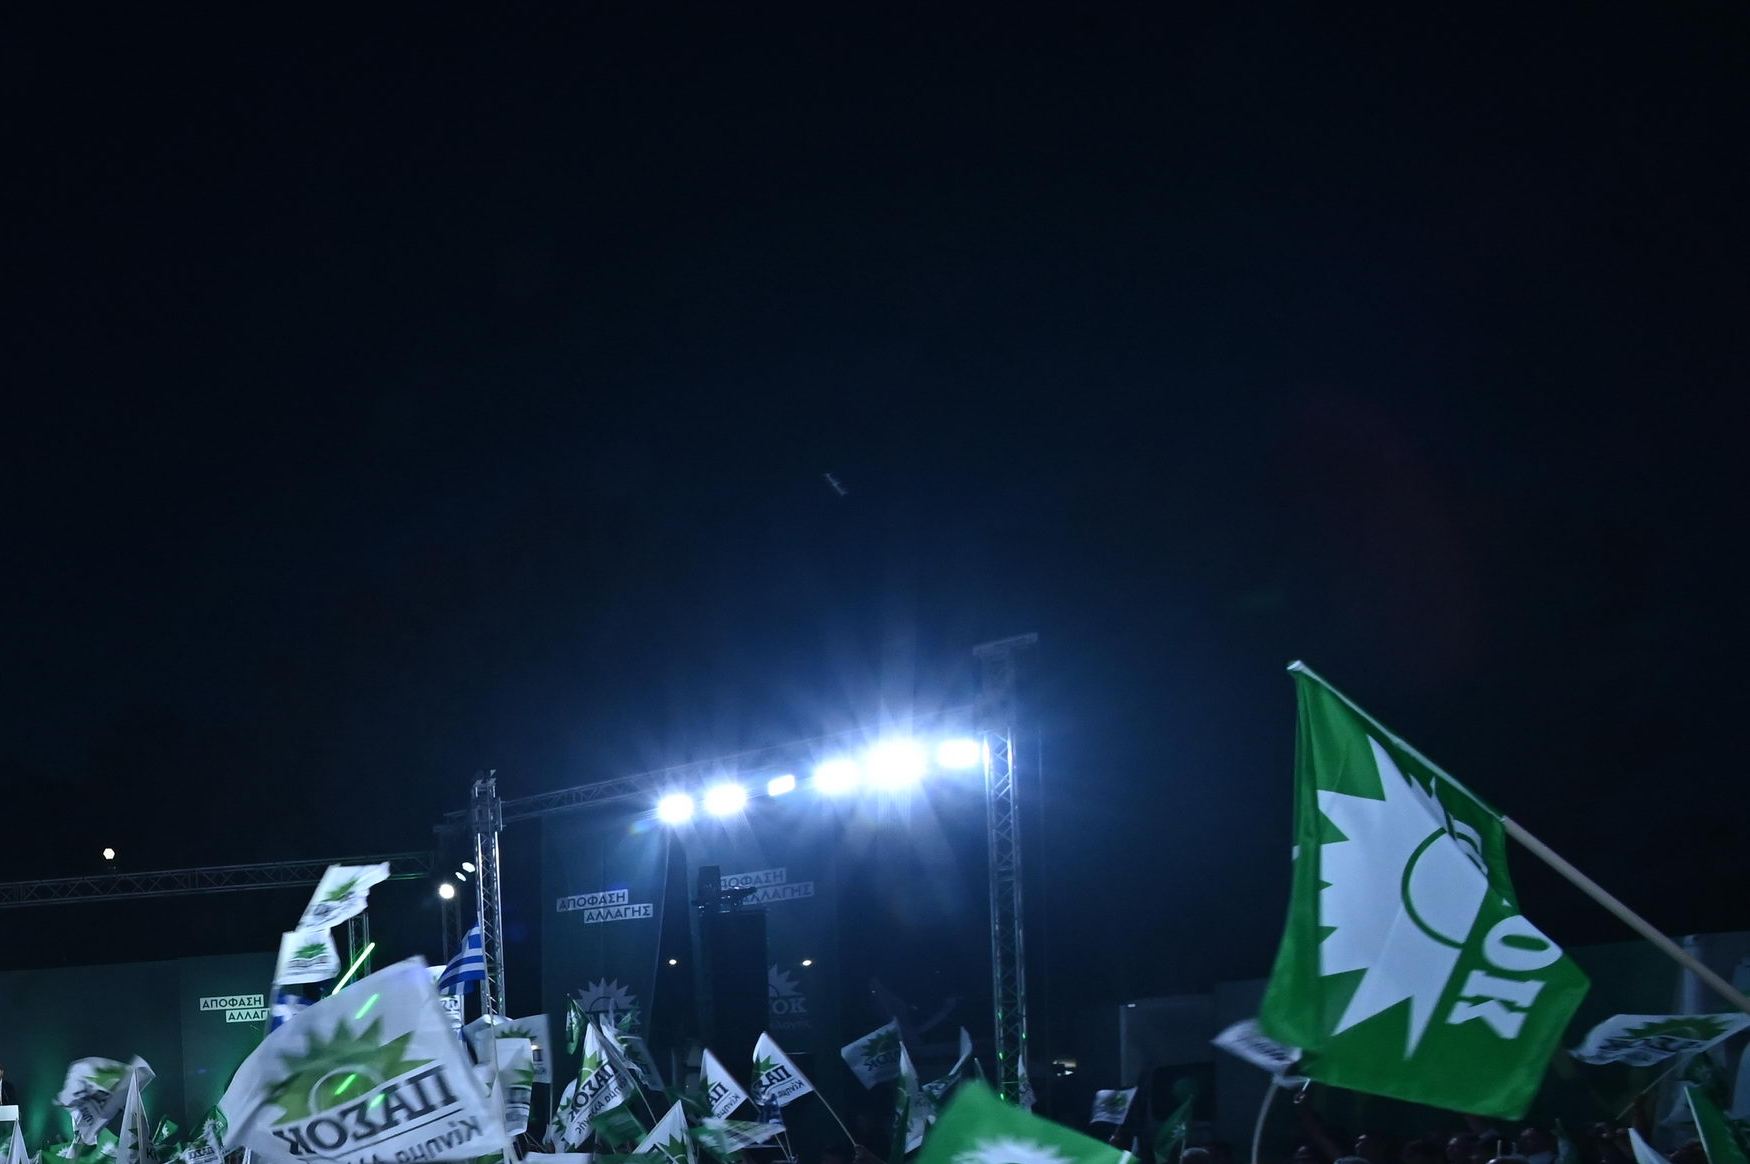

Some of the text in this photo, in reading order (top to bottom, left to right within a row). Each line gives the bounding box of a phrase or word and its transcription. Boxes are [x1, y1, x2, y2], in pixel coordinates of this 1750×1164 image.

[558, 891, 626, 910] ΑΠΟΦΑΣΗ
[586, 906, 651, 922] ΑΛΛΑΓΗΣ
[202, 997, 262, 1008] ΑΠΟΦΑΣΗ
[228, 1011, 267, 1021] ΑΛΛΑΓ
